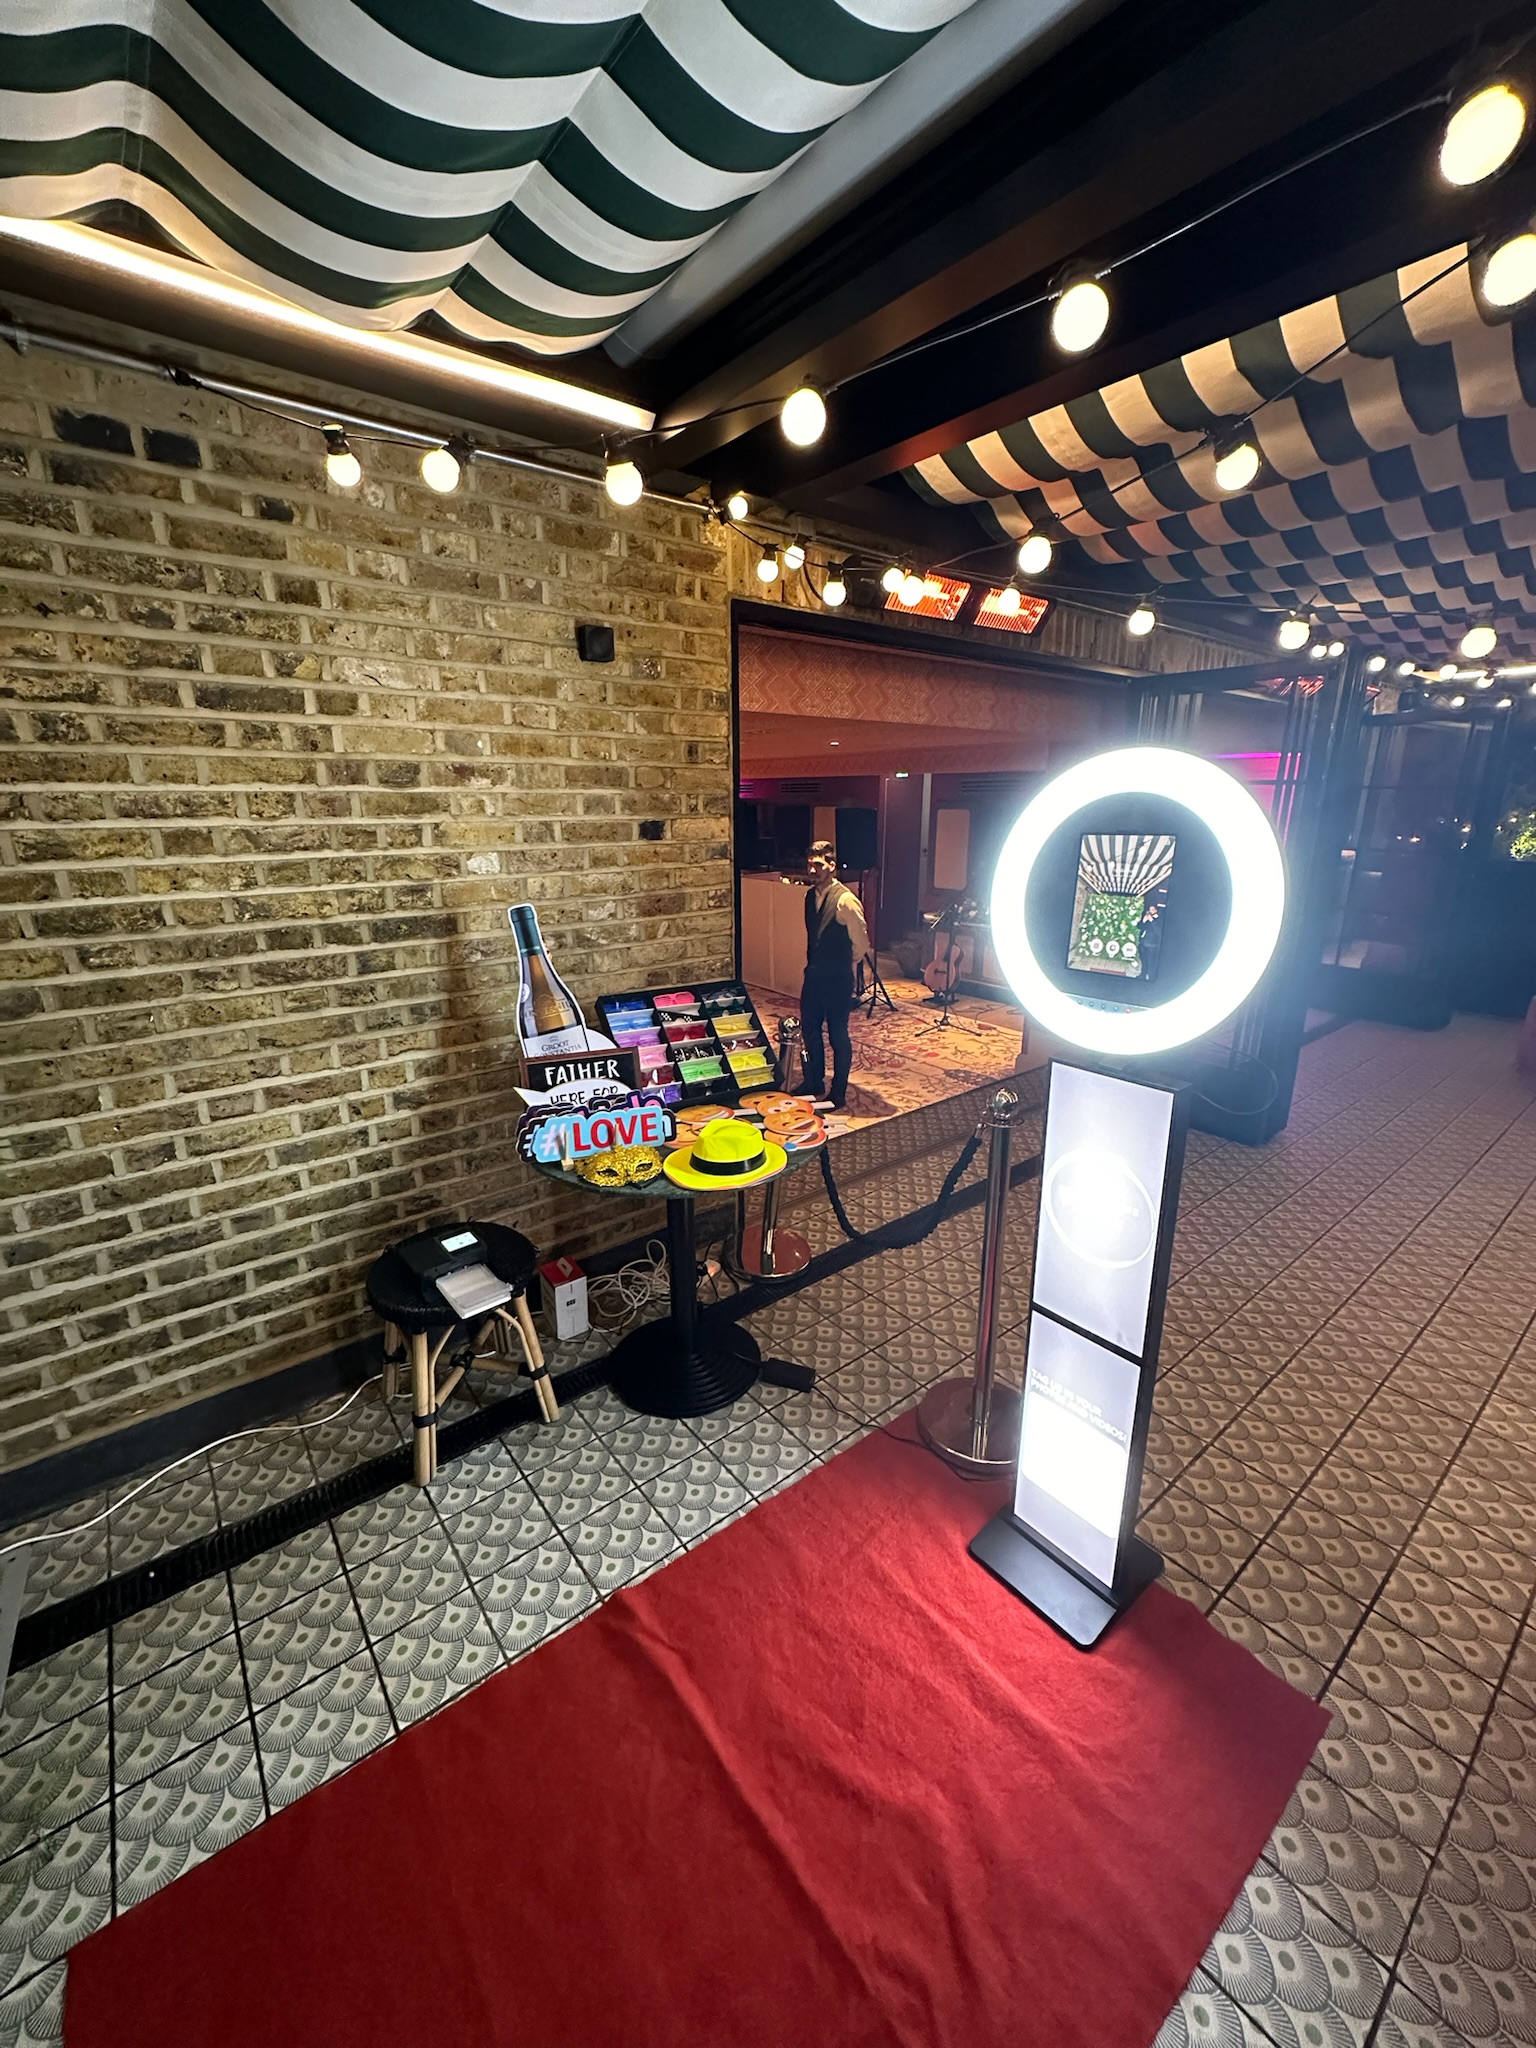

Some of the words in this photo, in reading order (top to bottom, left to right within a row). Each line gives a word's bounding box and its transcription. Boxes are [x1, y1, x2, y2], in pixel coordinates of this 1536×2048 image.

[541, 1039, 569, 1052] GROOT
[544, 1059, 620, 1086] FATHER
[539, 1112, 659, 1157] #LOVE
[1031, 1367, 1049, 1385] TAG
[1075, 1395, 1102, 1417] YOUR
